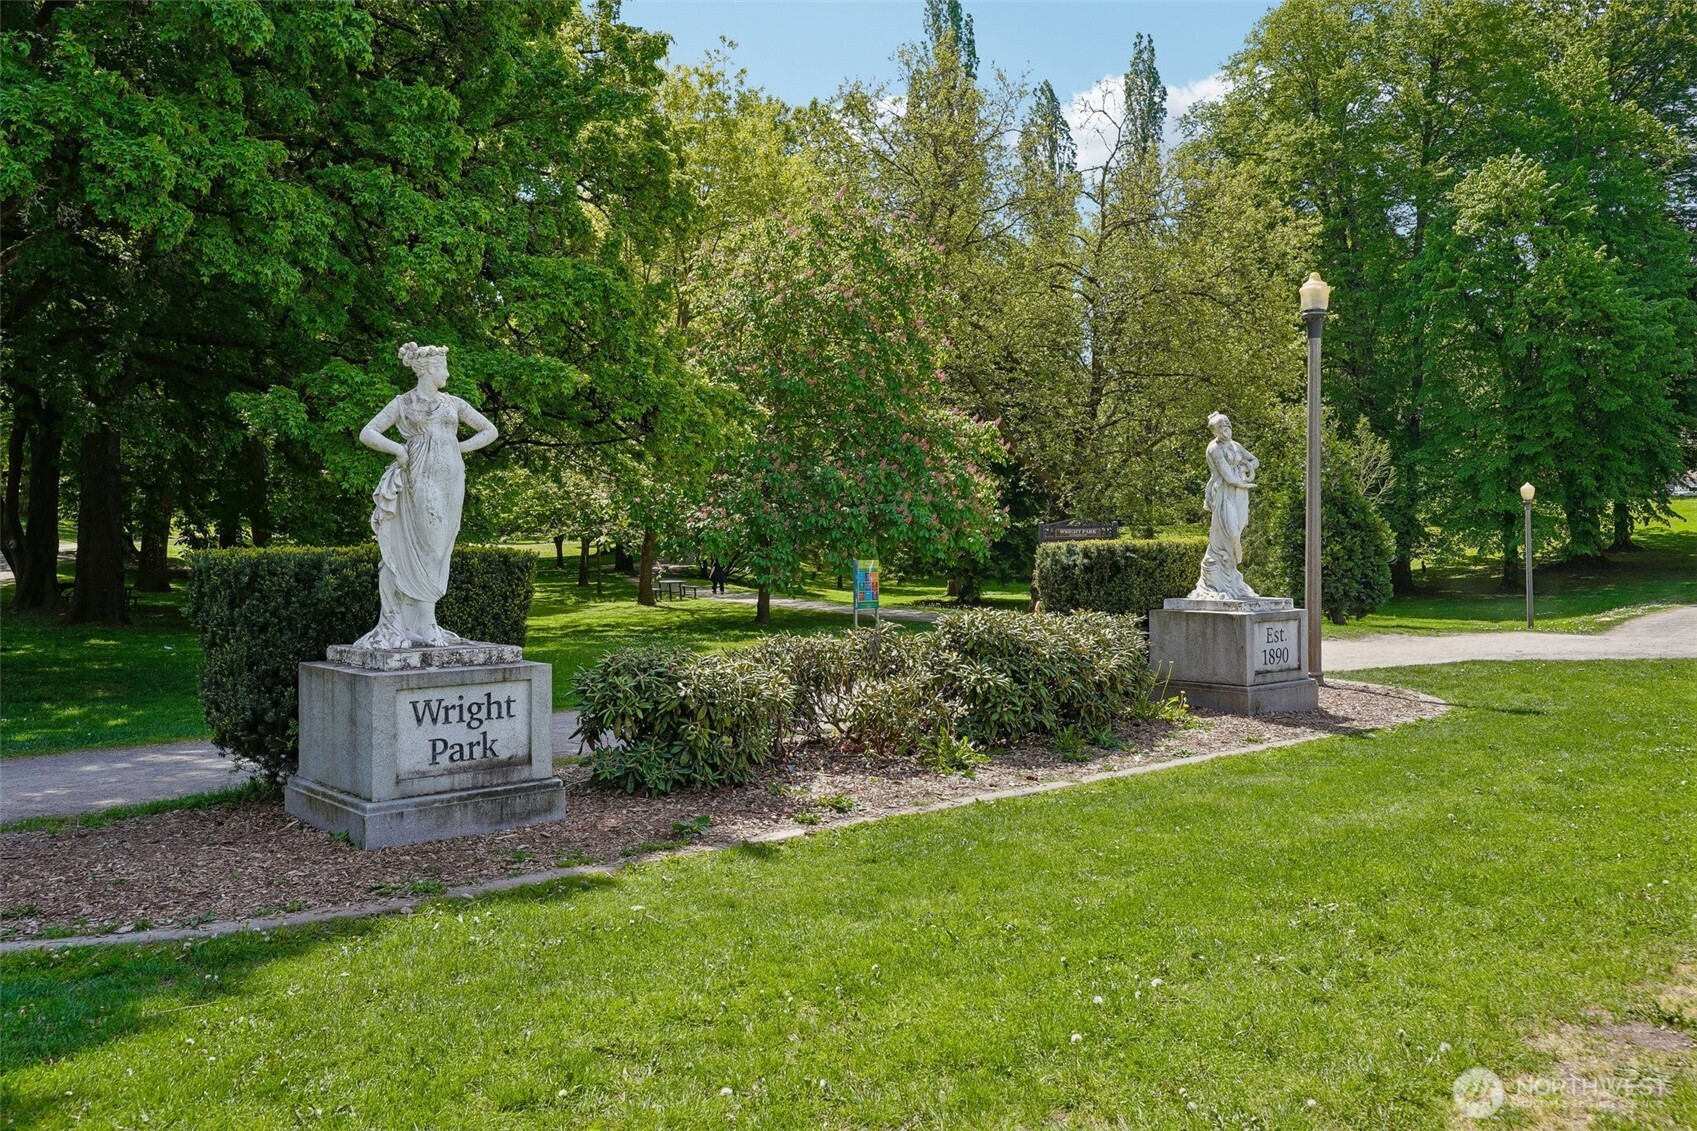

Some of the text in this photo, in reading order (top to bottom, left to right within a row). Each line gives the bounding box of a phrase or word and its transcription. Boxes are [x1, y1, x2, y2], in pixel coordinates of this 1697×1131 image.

[1266, 627, 1287, 643] Est.
[1262, 647, 1289, 665] 1890
[409, 692, 516, 730] Wright
[428, 731, 499, 765] Park
